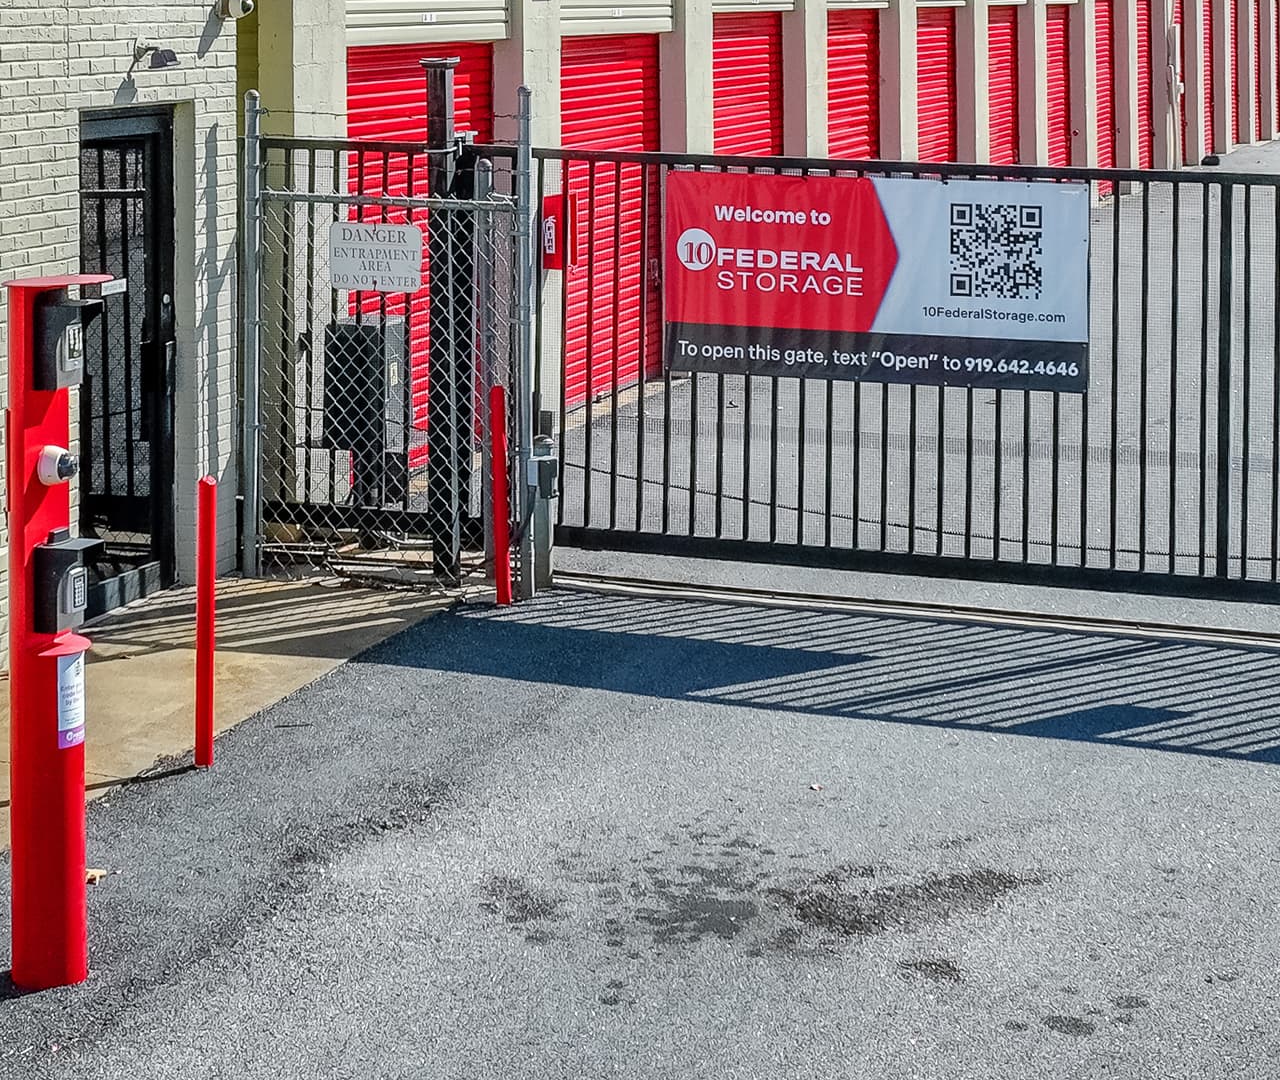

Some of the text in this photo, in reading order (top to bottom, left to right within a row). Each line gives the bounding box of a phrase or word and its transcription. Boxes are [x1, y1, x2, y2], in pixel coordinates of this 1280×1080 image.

[714, 205, 831, 225] Welcome to
[342, 228, 407, 243] DANGER
[333, 247, 418, 261] ENTRAPMENT
[683, 242, 863, 273] 10 FEDERAL
[359, 261, 392, 271] AREA
[334, 274, 417, 287] DO NOT ENTER
[717, 271, 863, 296] STORAGE
[923, 306, 1066, 324] 10FederalStorage.com
[678, 340, 1079, 377] To open this gate, text “Open” to 919.642.4646
